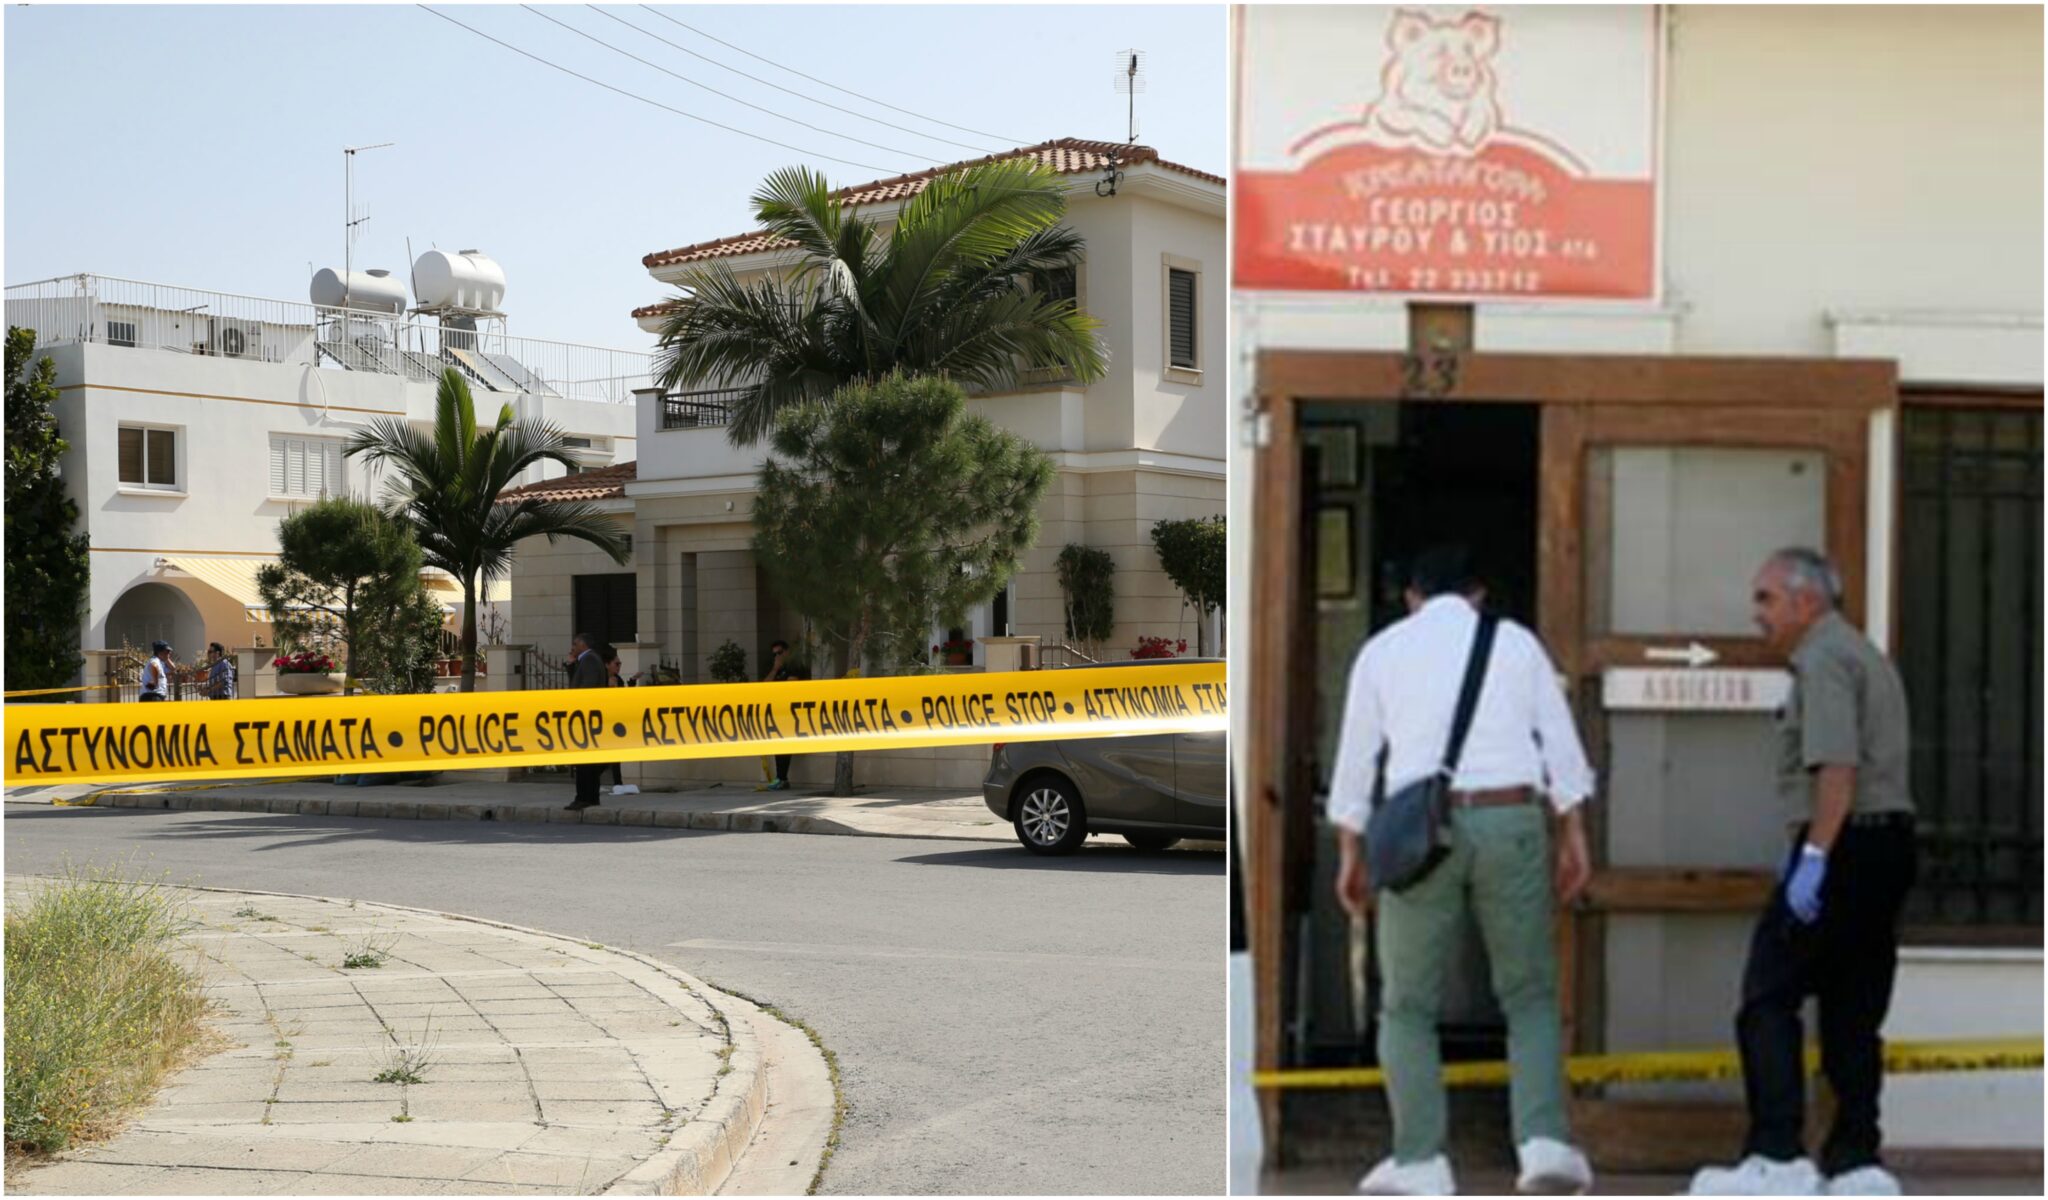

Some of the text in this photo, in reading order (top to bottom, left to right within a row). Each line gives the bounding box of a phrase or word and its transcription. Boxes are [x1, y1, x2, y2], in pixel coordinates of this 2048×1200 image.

[1370, 198, 1518, 227] ΓΕΩΡΓΙΟΣ
[1289, 223, 1433, 255] ΣΤΑΥΡΟΥ
[1483, 230, 1548, 258] ΥΙΟΣ
[15, 682, 1227, 774] ΑΣΤΥΝΟΜΙΑ ΣΤΑΜΑΤΑ POLICE STOP ΑΣΤΥΝΟΜΙΑ ΣΤΑΜΑΤΑ POLICE STOP ΑΣΤΥΝΟΜΙΑ ΣΤΑ
